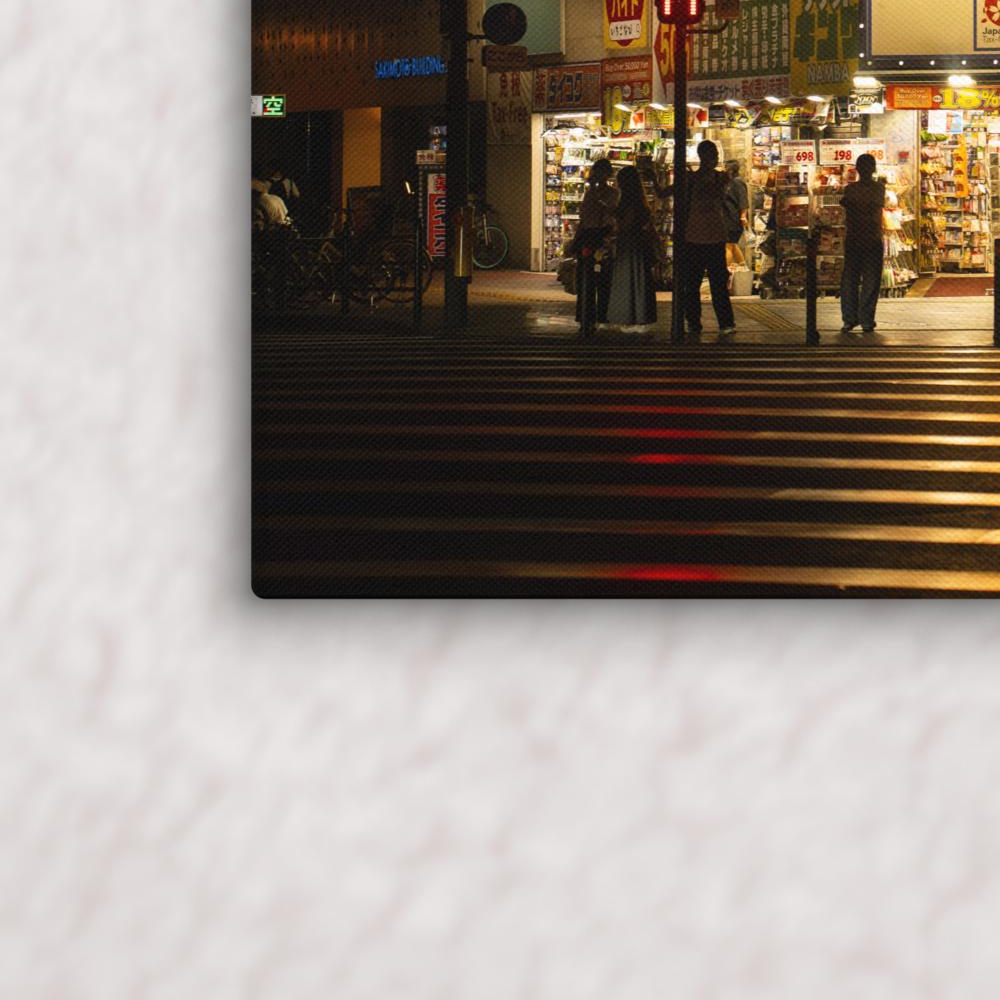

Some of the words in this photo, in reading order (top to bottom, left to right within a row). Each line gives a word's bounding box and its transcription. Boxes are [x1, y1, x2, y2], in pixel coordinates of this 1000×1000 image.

[807, 62, 848, 83] NAMBA
[263, 96, 284, 116] 空
[795, 151, 814, 163] 698
[834, 149, 851, 161] 198
